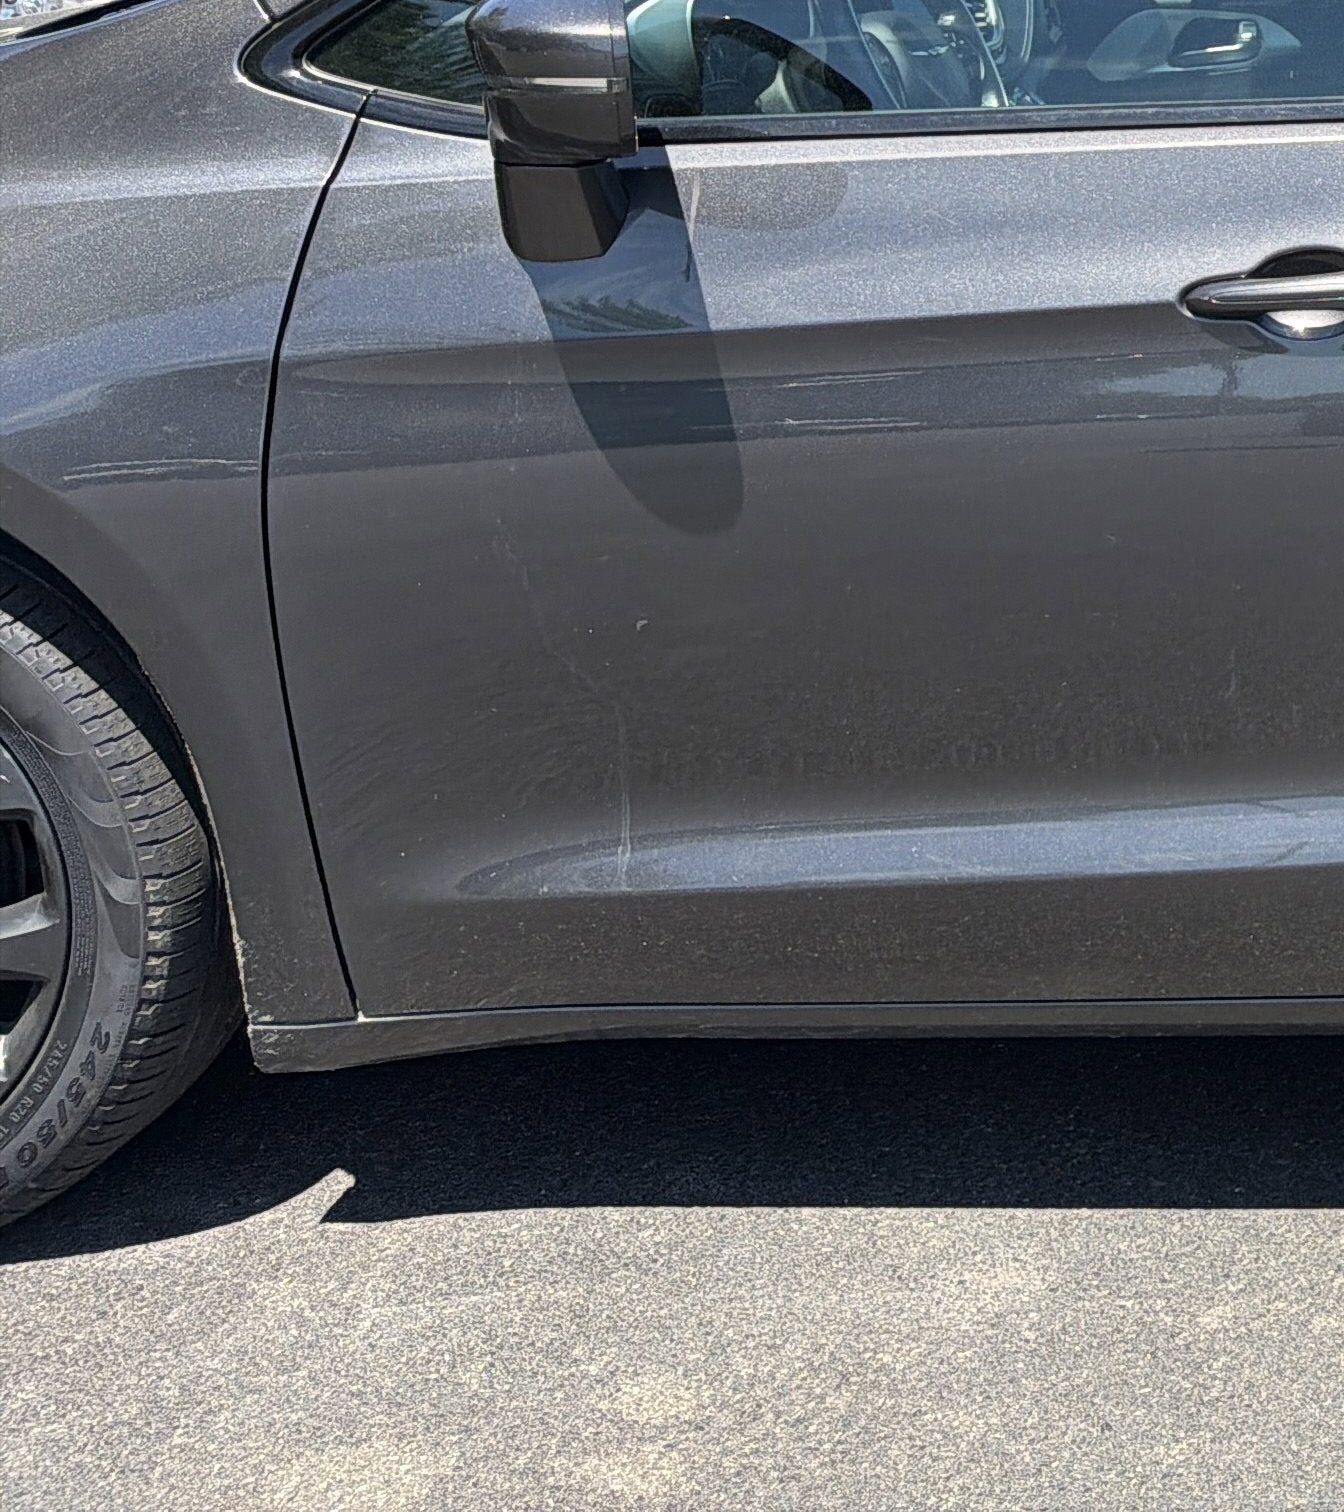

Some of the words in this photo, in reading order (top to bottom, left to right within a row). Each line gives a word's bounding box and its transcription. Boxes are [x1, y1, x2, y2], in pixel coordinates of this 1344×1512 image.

[31, 1039, 68, 1093] 245/50
[9, 1096, 34, 1123] R20
[17, 1021, 110, 1168] 245/50
